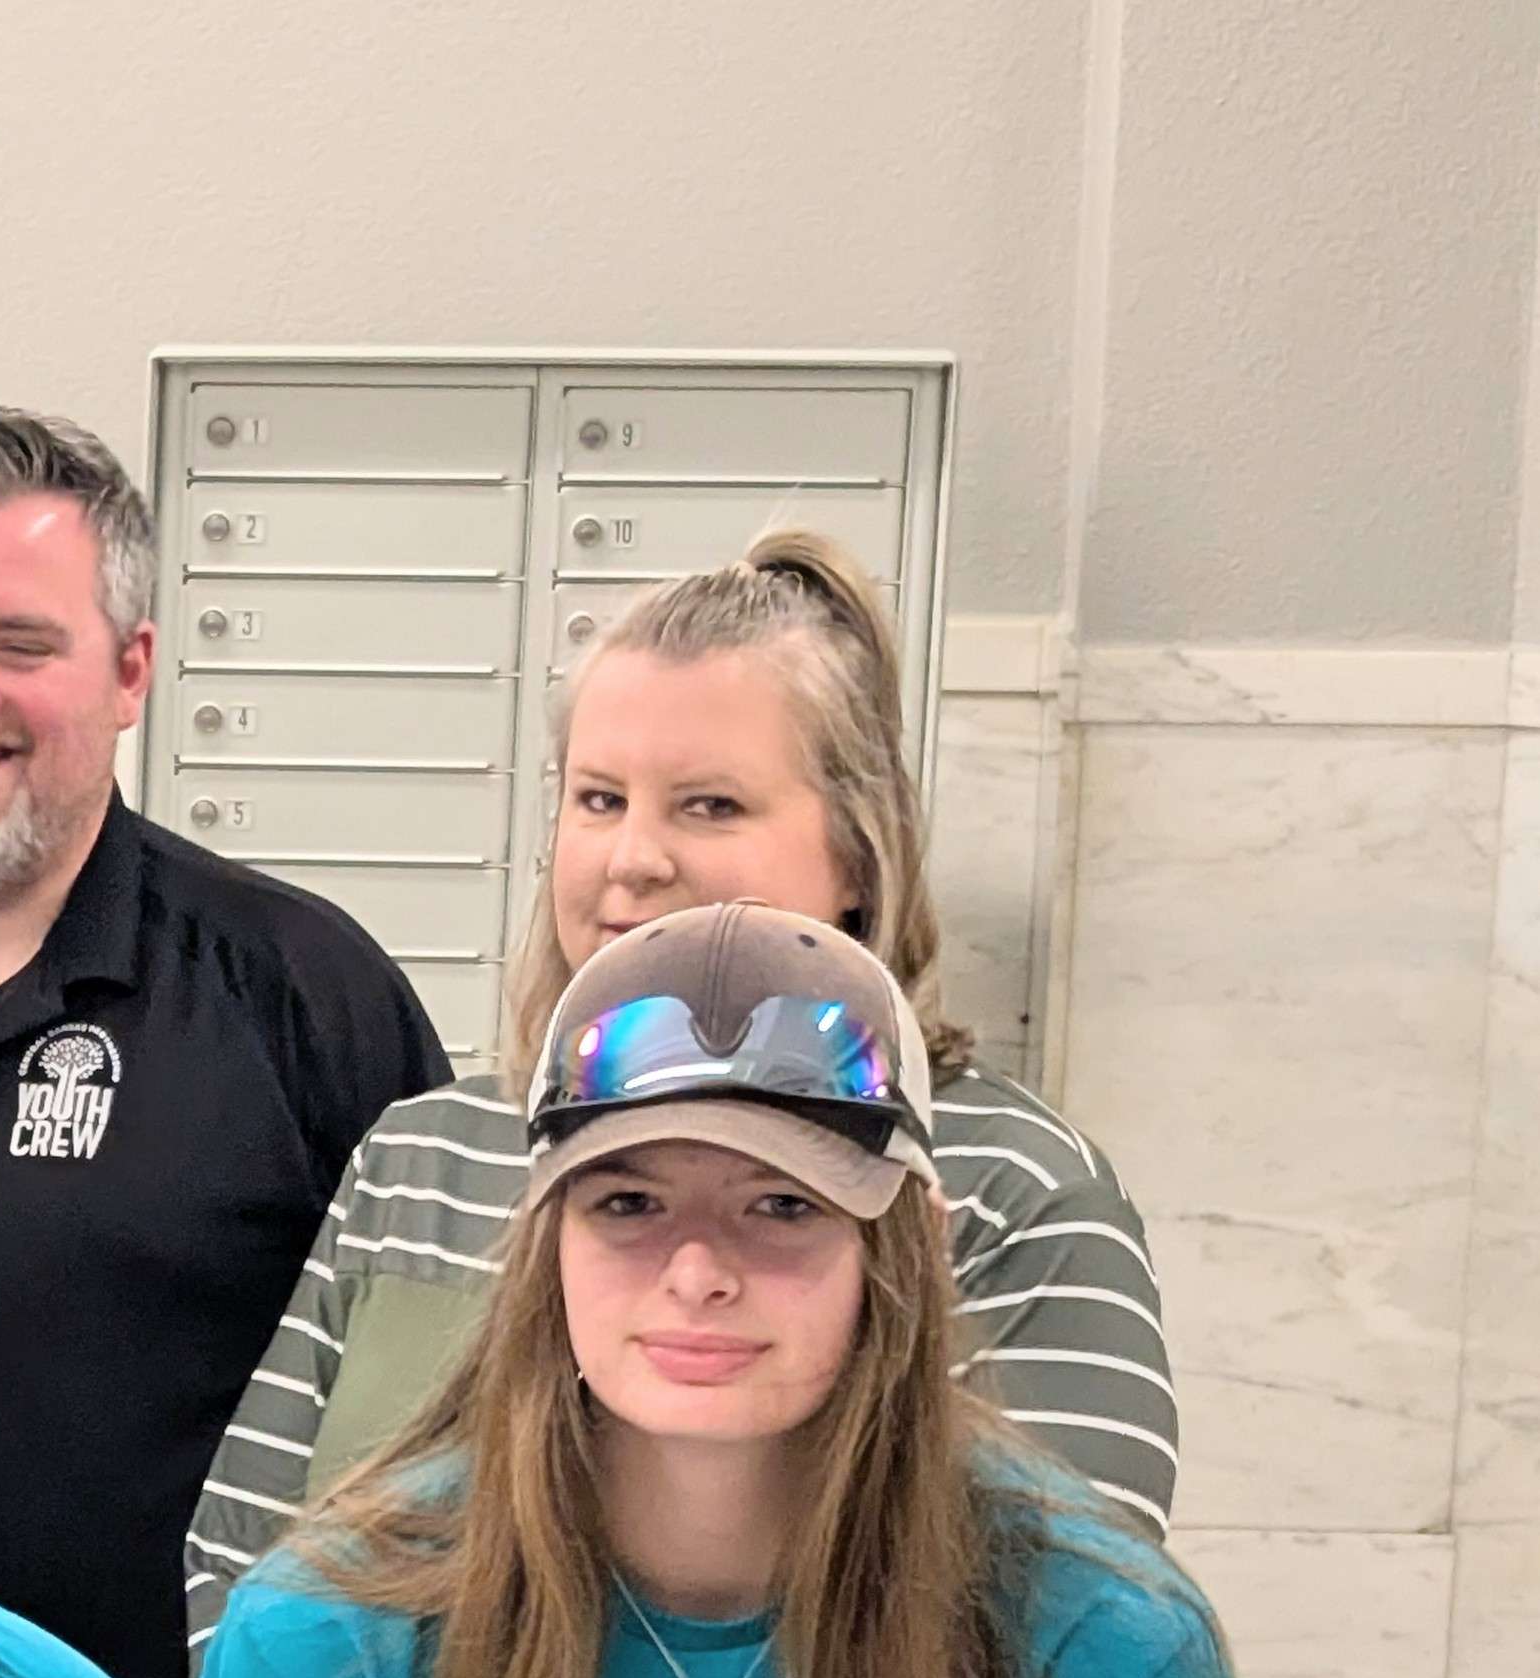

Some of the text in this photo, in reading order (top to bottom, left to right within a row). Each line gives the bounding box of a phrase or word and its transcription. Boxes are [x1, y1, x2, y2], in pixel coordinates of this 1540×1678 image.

[622, 423, 633, 447] 9
[246, 514, 256, 539] 2
[614, 519, 632, 543] 10
[242, 611, 252, 636] 3
[238, 706, 248, 731] 4
[234, 801, 243, 825] 5
[17, 1083, 115, 1125] YOUTH
[9, 1119, 107, 1160] CREW
